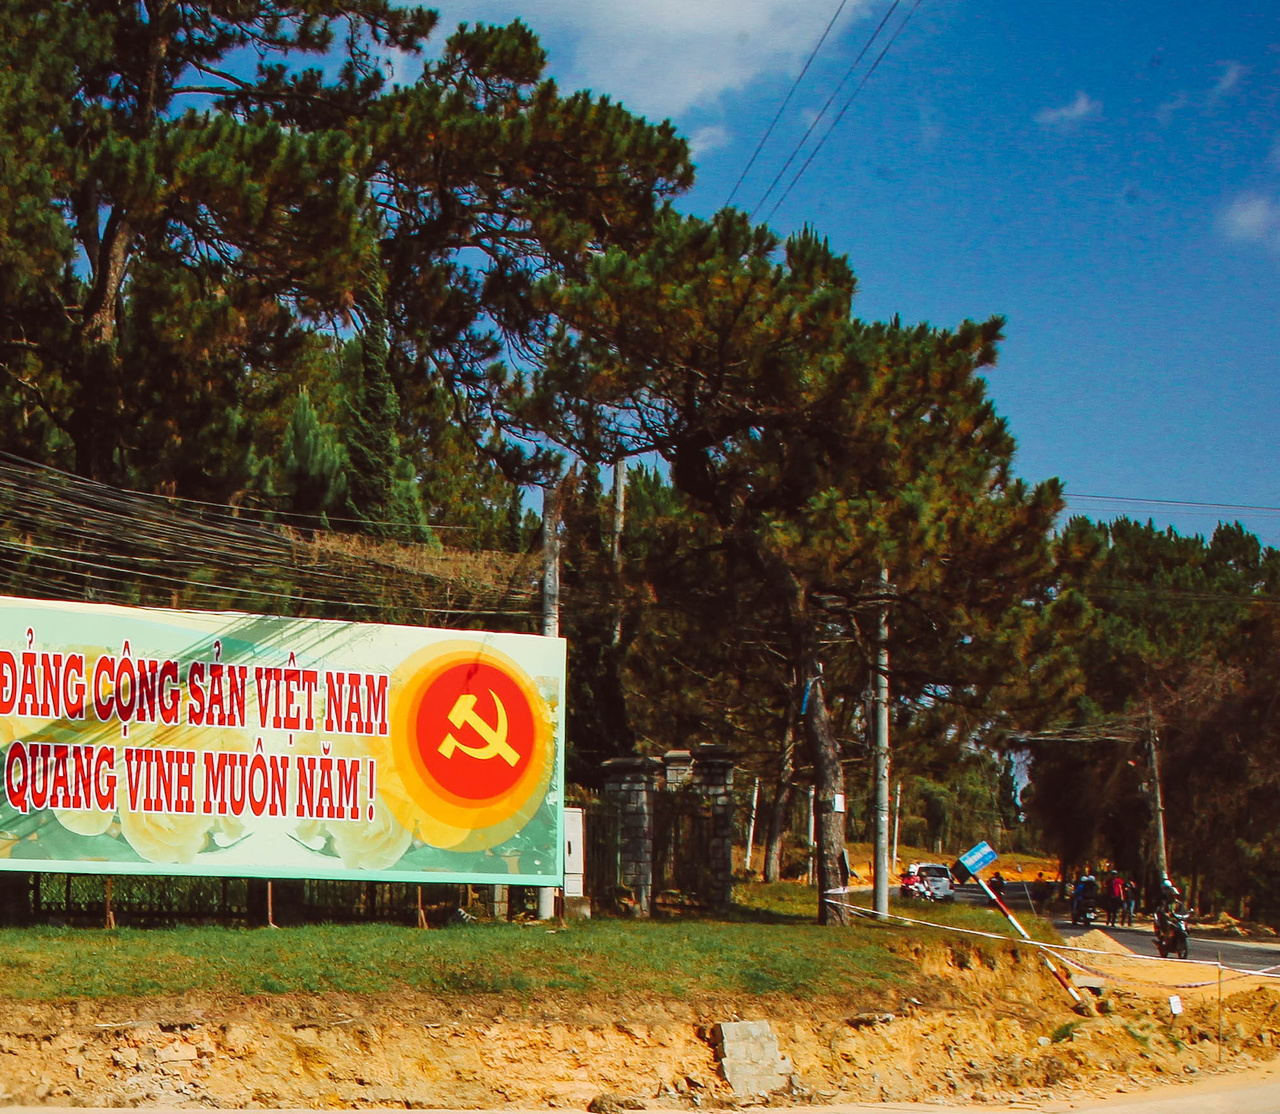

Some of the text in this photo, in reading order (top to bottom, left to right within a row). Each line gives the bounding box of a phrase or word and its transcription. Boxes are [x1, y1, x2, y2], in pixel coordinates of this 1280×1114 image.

[93, 639, 182, 737] CỘNG
[187, 639, 249, 729] SẢN
[253, 650, 319, 746] VIỆT
[324, 670, 389, 736] NAM
[5, 741, 118, 814] QUANG
[123, 747, 197, 814] VINH
[202, 736, 291, 818] MUÔN
[295, 741, 361, 821] NĂM
